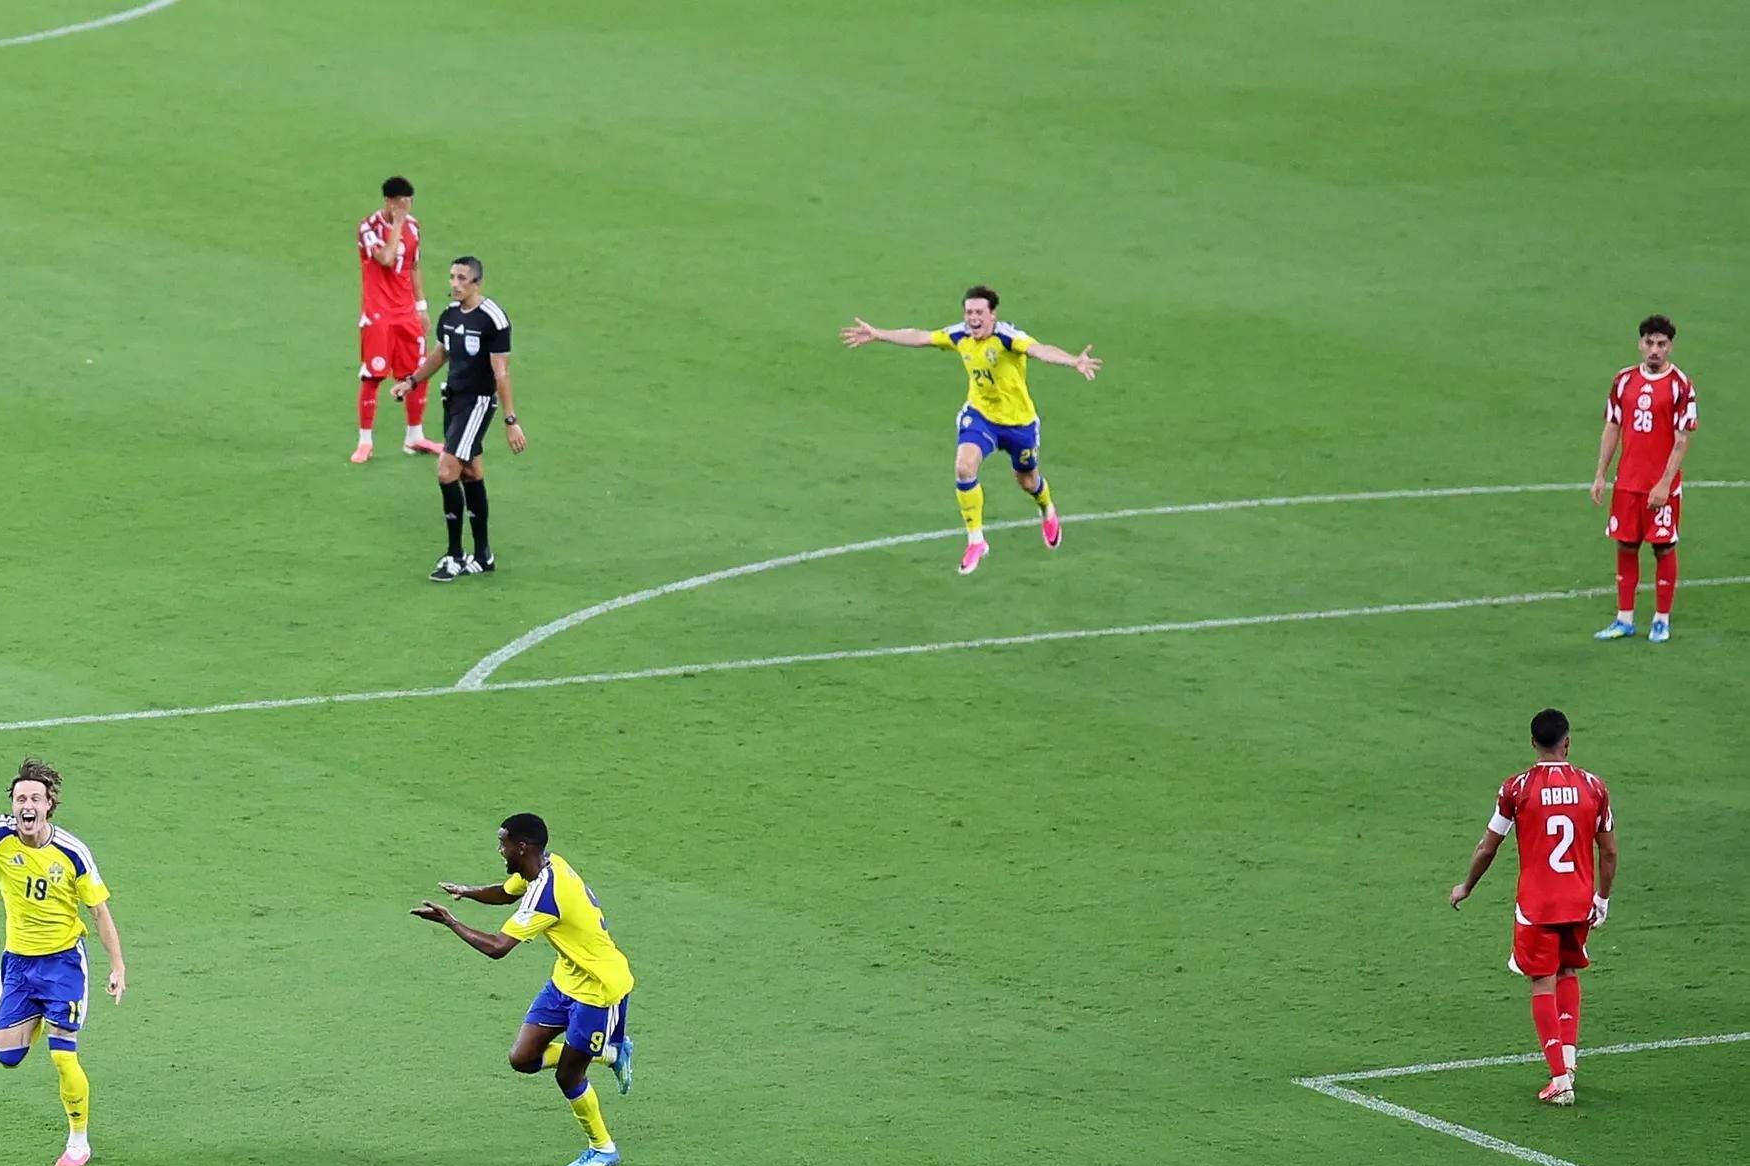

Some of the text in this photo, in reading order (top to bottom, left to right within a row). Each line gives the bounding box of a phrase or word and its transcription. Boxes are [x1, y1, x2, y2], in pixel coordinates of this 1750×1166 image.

[972, 368, 995, 387] 24
[1633, 409, 1653, 433] 26
[1540, 786, 1580, 806] ABDI
[1545, 814, 1576, 875] 2
[26, 876, 48, 901] 19
[590, 1031, 604, 1053] 9
